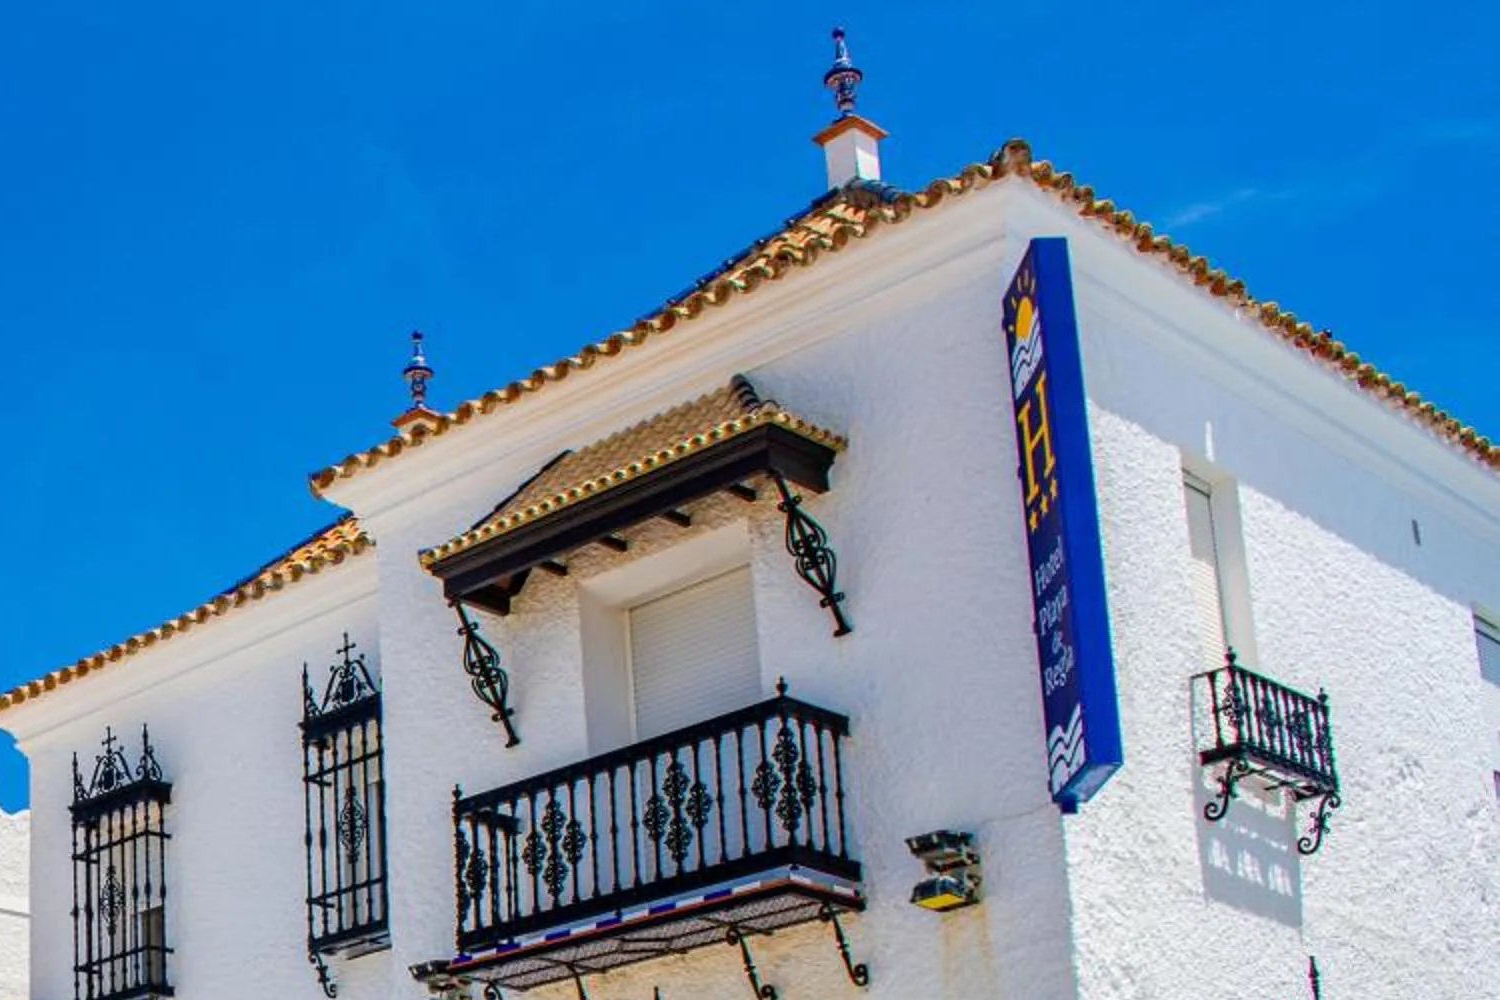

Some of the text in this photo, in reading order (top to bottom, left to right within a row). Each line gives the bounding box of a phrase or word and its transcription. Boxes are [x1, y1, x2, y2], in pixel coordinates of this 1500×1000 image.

[1017, 370, 1056, 506] H
[1035, 536, 1064, 597] Hotel
[1038, 584, 1068, 637] Playa
[1044, 645, 1075, 697] Regla
